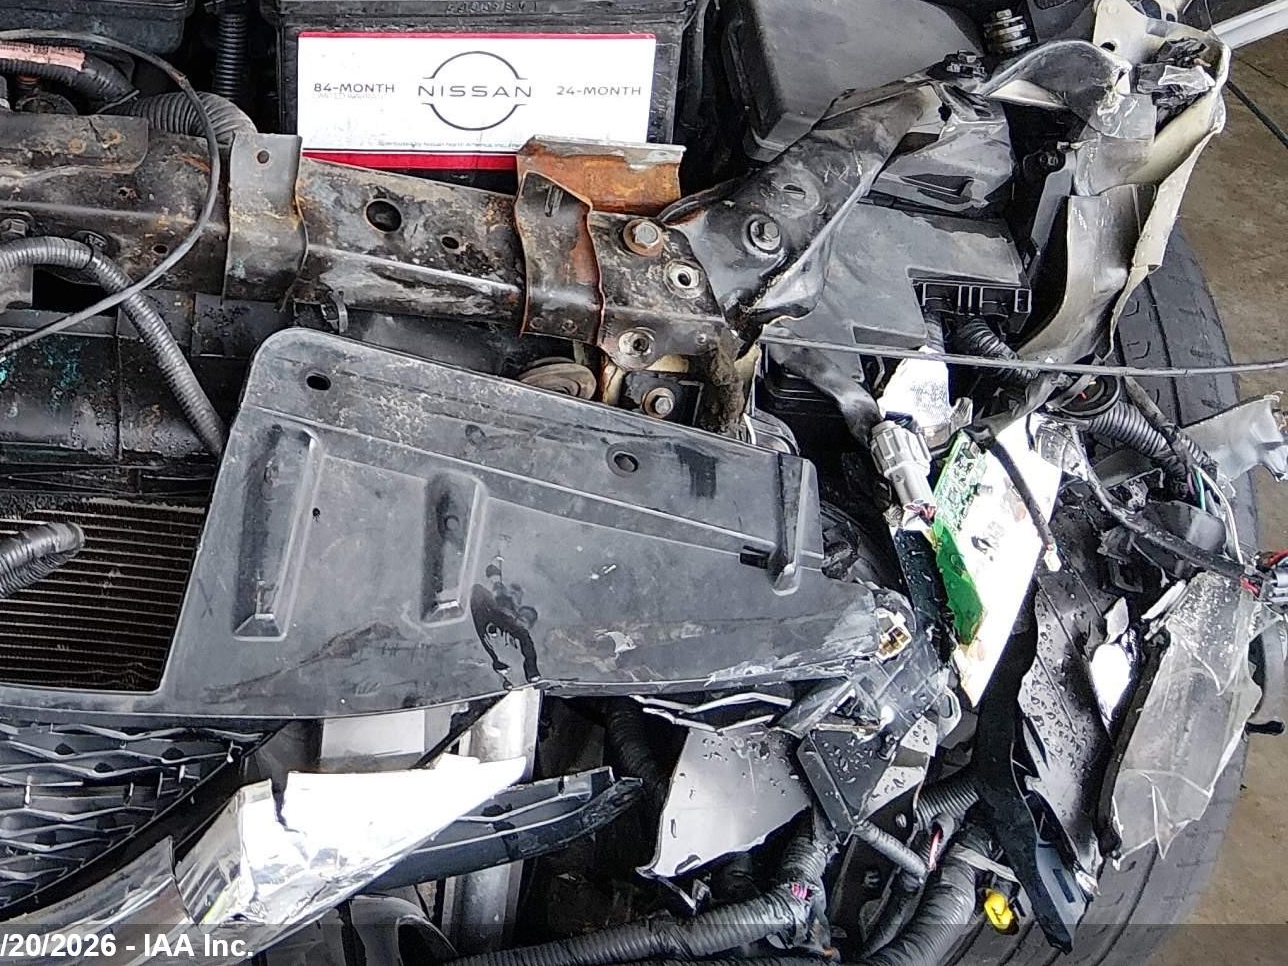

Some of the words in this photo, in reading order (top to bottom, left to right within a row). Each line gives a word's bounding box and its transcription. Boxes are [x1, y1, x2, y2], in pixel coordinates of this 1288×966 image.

[312, 82, 395, 94] 84-MONTH
[417, 84, 532, 99] NISSAN
[556, 85, 641, 96] 24-MONTH
